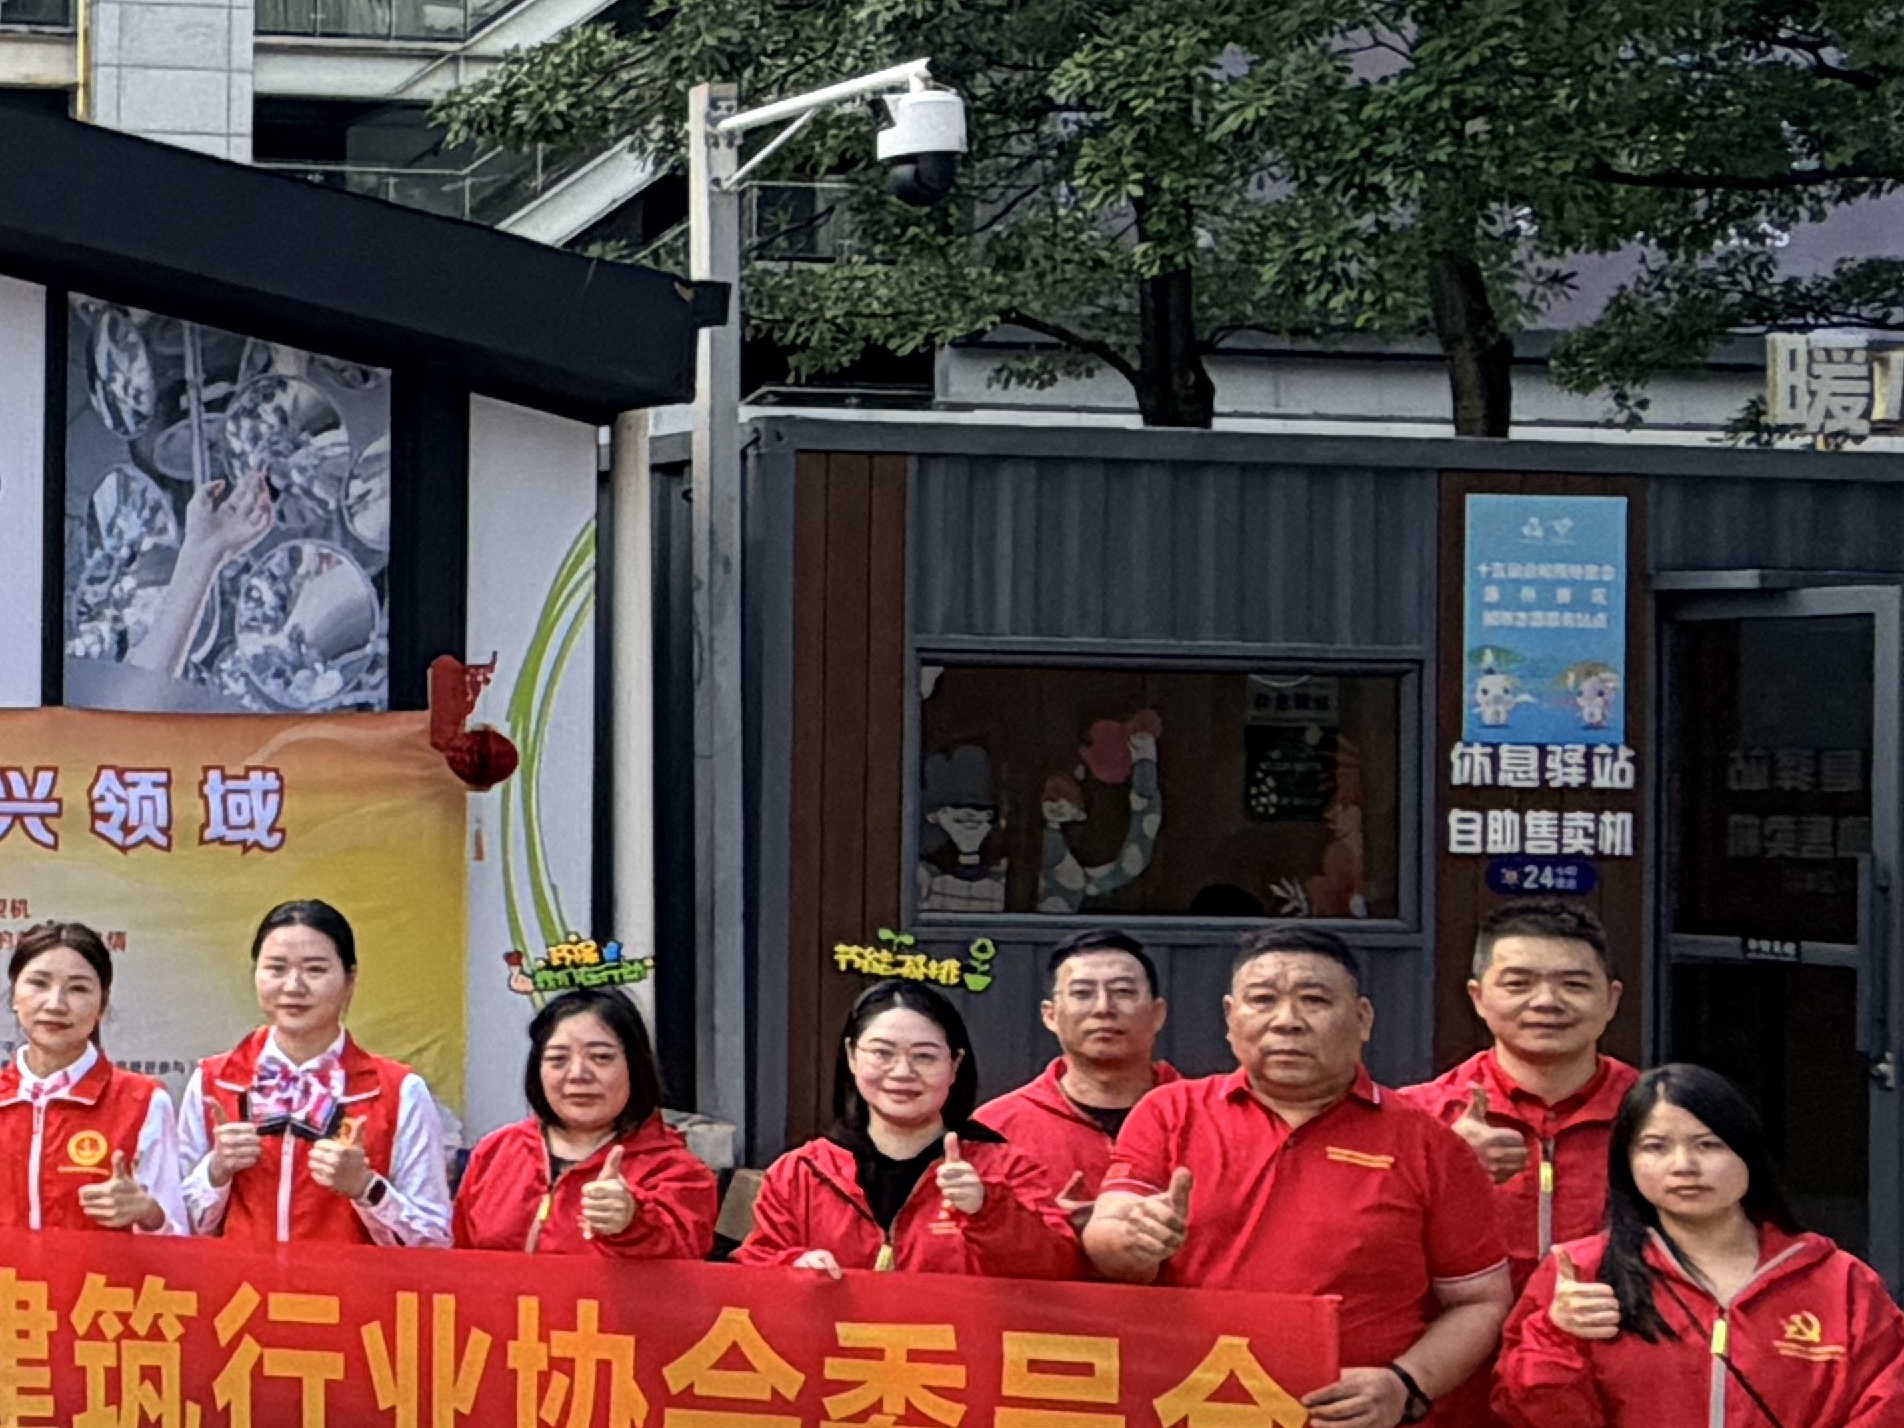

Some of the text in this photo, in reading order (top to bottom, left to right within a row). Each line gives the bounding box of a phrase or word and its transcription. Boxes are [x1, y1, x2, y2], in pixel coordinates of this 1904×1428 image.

[1766, 328, 1904, 436] 暖
[1450, 741, 1636, 789] 休息驿站
[1448, 808, 1634, 856] 自助售卖机
[1523, 865, 1554, 890] 24
